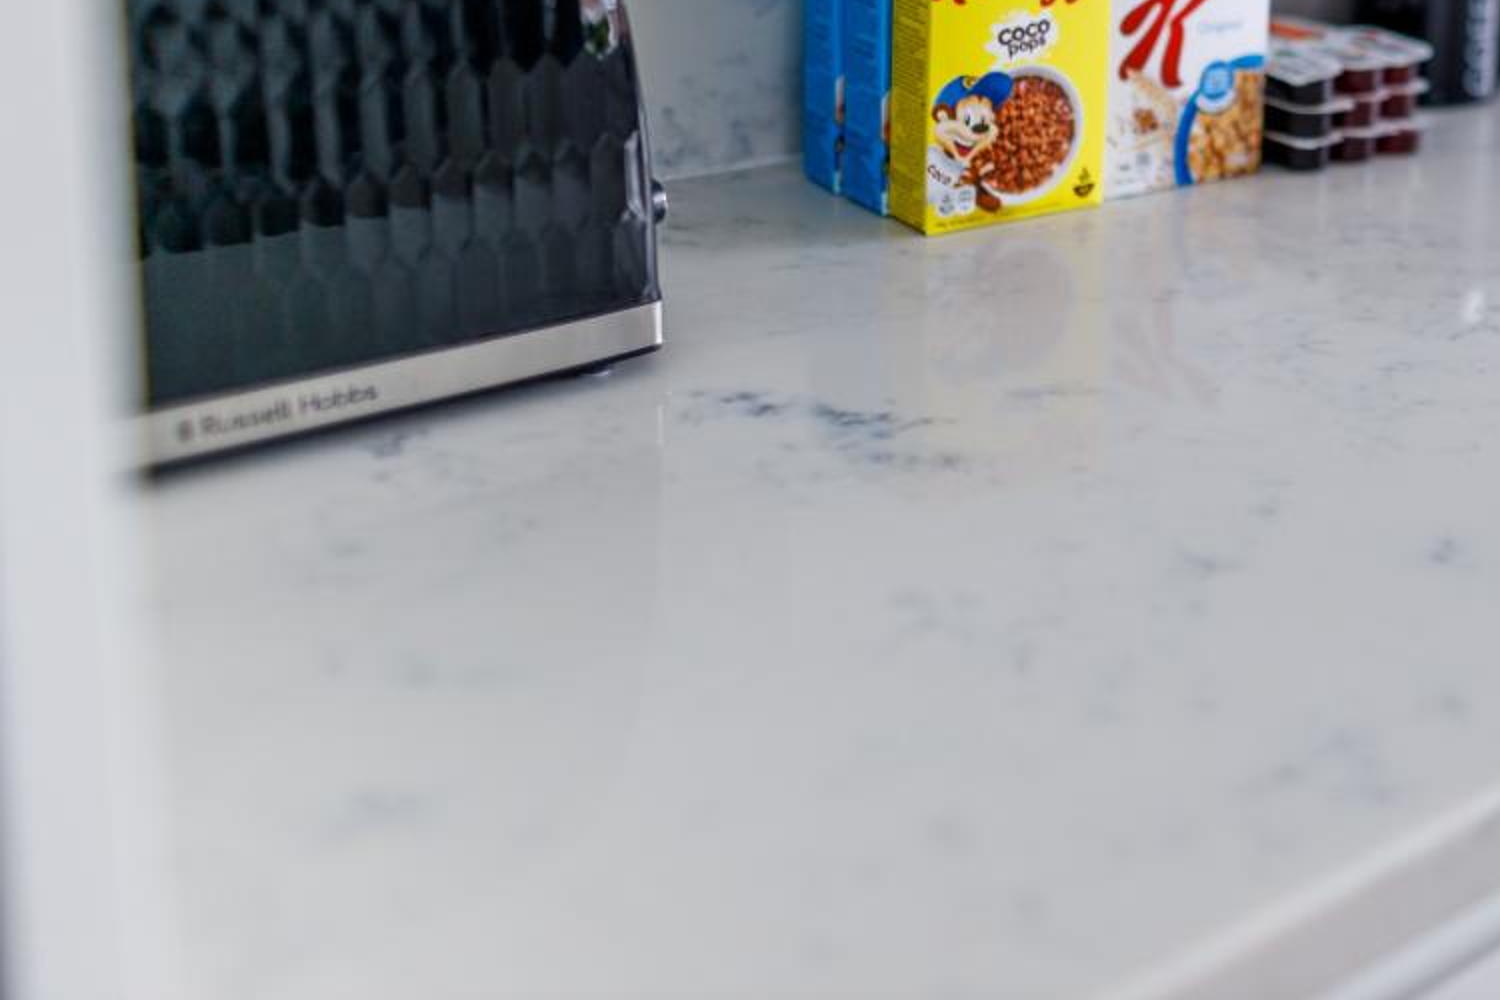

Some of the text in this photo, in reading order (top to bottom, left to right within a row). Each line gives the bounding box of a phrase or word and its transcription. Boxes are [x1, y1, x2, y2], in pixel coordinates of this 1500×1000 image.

[1007, 36, 1047, 60] pops
[201, 385, 378, 434] Russell Hobbs
